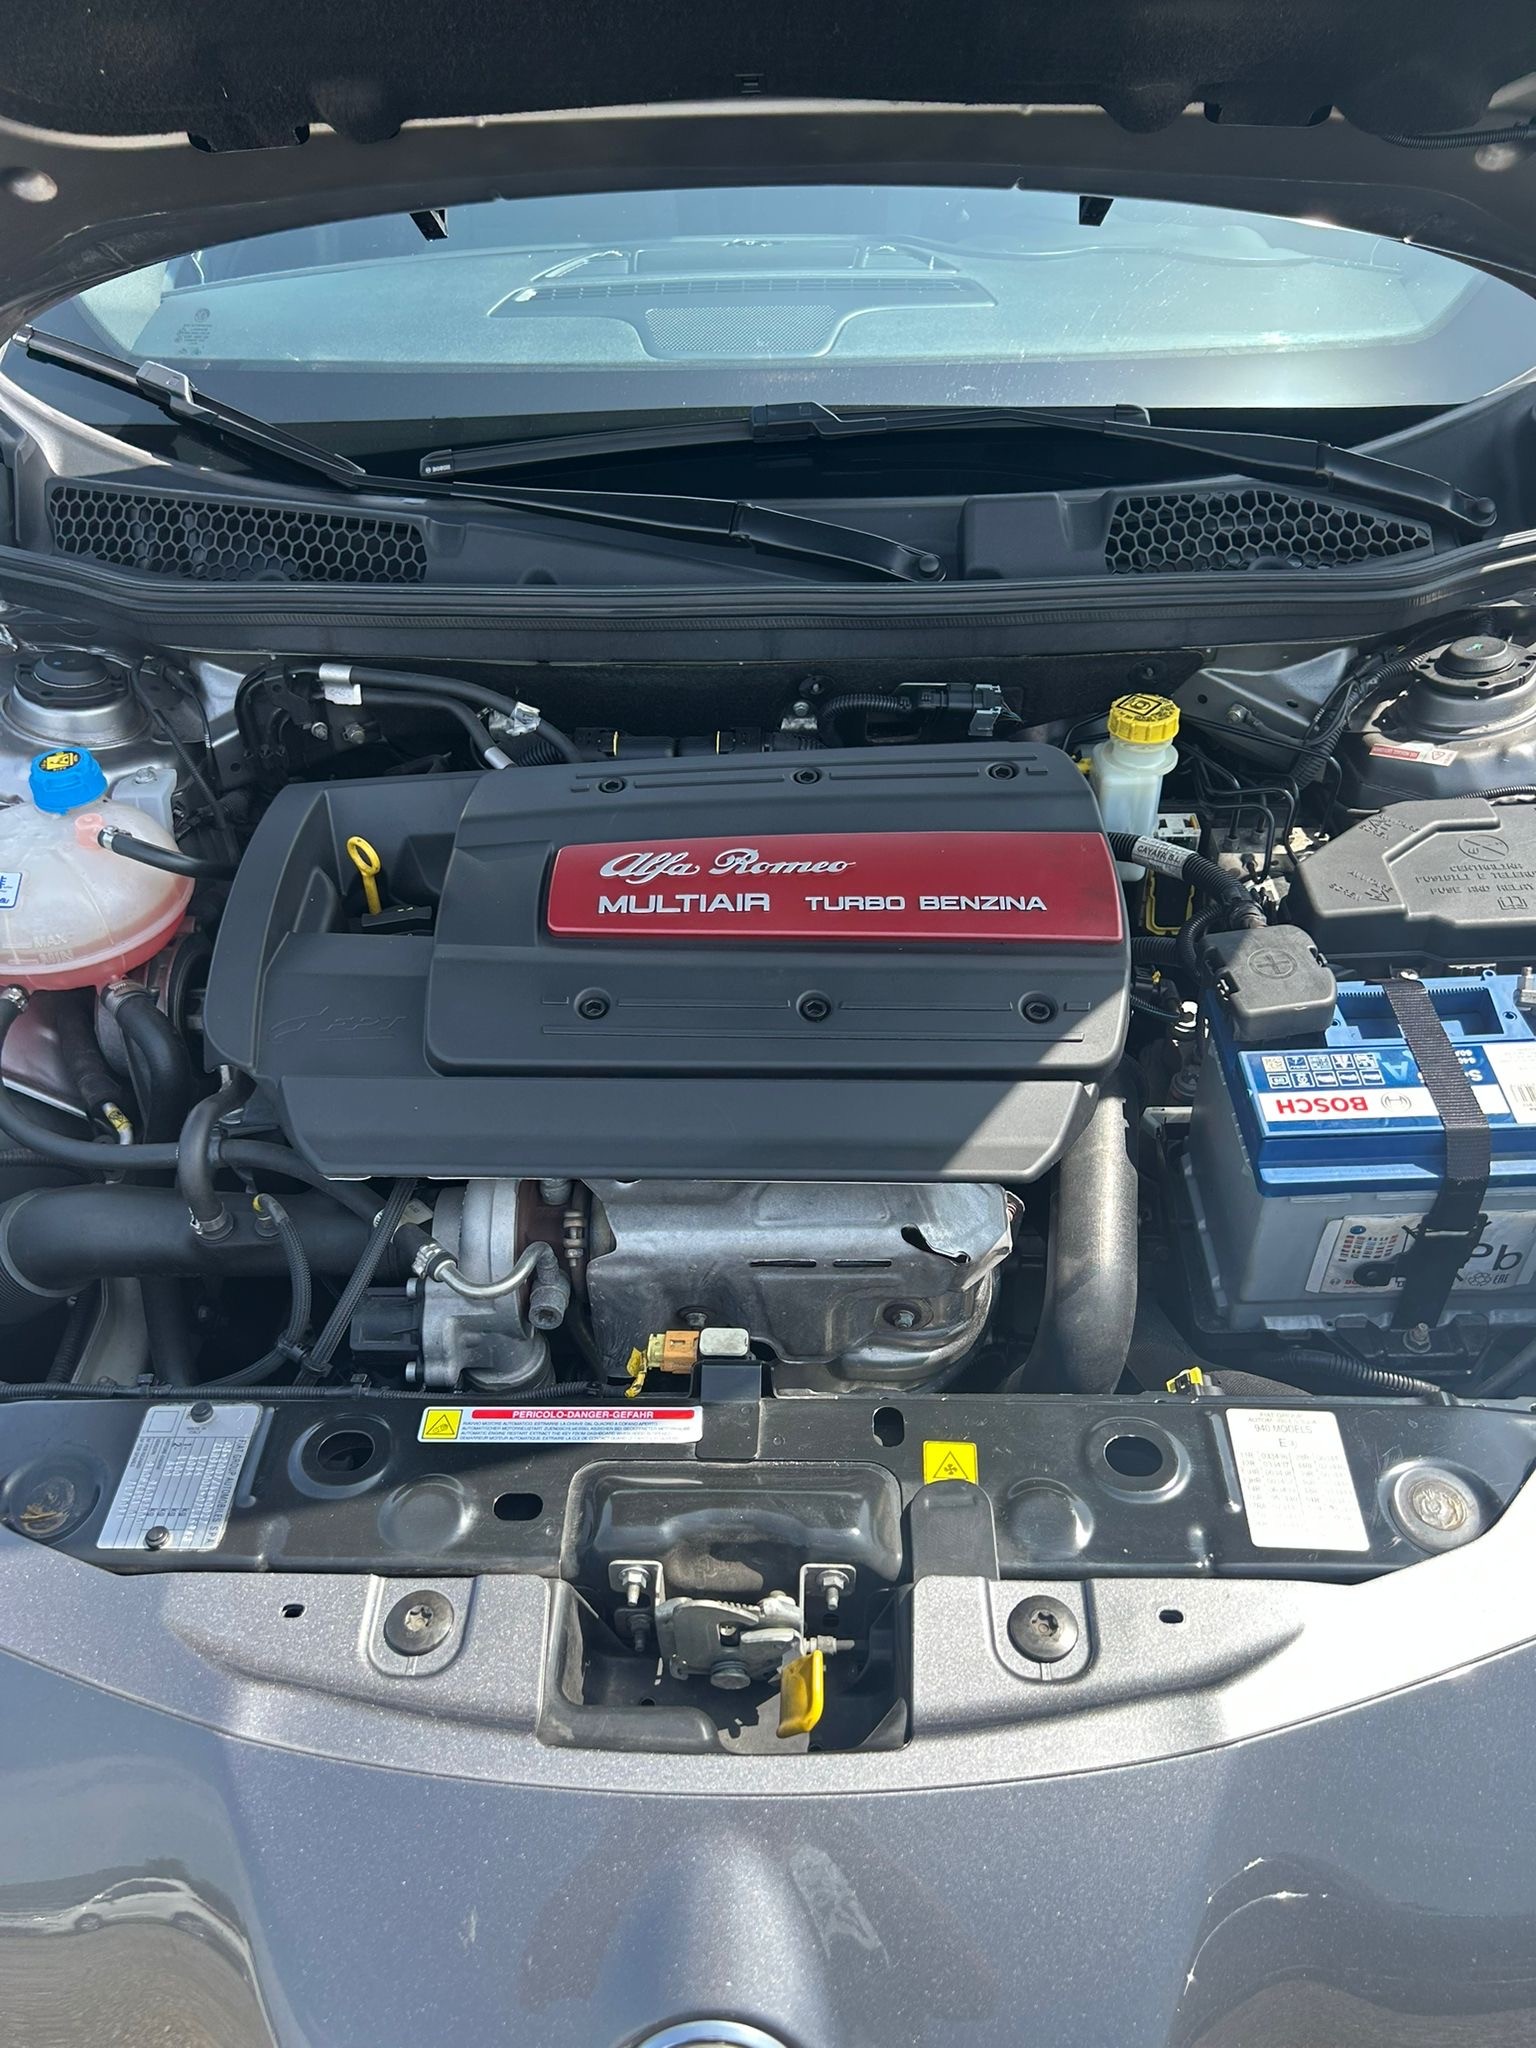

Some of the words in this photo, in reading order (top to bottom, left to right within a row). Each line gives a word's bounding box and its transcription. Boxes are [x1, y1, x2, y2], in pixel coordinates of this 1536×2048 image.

[600, 852, 700, 884] Alfa
[709, 848, 855, 875] Romeo
[598, 892, 770, 914] MULTIAIR
[805, 895, 906, 912] TURBO
[919, 895, 1047, 912] BENZINA
[1277, 1096, 1368, 1114] BOSCH
[1470, 1243, 1522, 1271] Pb
[512, 1410, 654, 1419] PERICOLO-DANGER-GEFAHR
[236, 1439, 247, 1452] FIAT
[230, 1454, 242, 1475] GROUP
[212, 1477, 233, 1522] AUTOMOBILES
